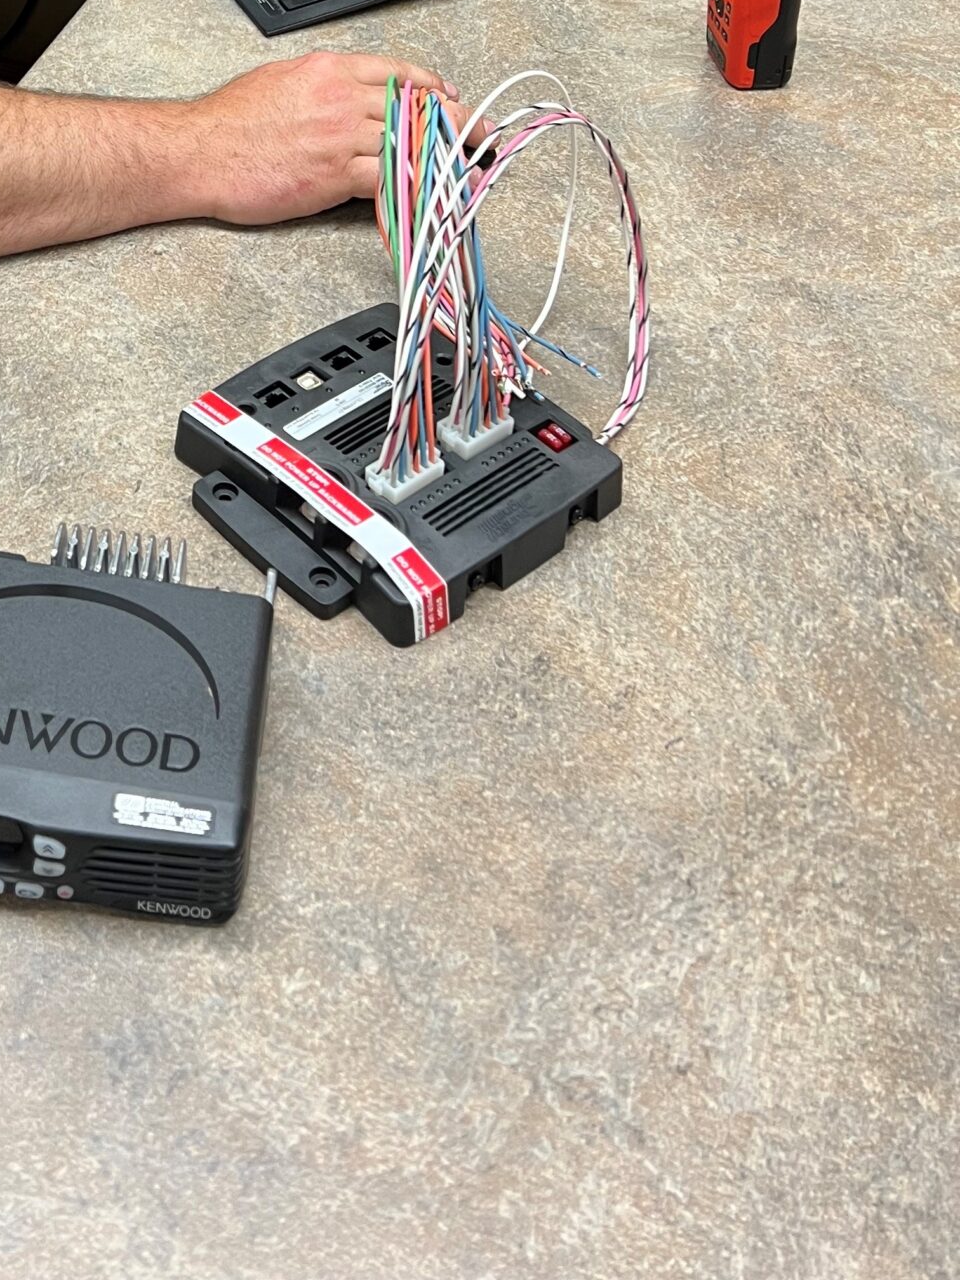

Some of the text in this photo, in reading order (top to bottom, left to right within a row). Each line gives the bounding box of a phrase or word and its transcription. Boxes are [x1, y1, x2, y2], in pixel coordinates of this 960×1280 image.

[260, 444, 273, 454] DO
[396, 555, 409, 569] DO
[406, 567, 424, 585] NOT
[137, 899, 212, 919] KENWOOD
